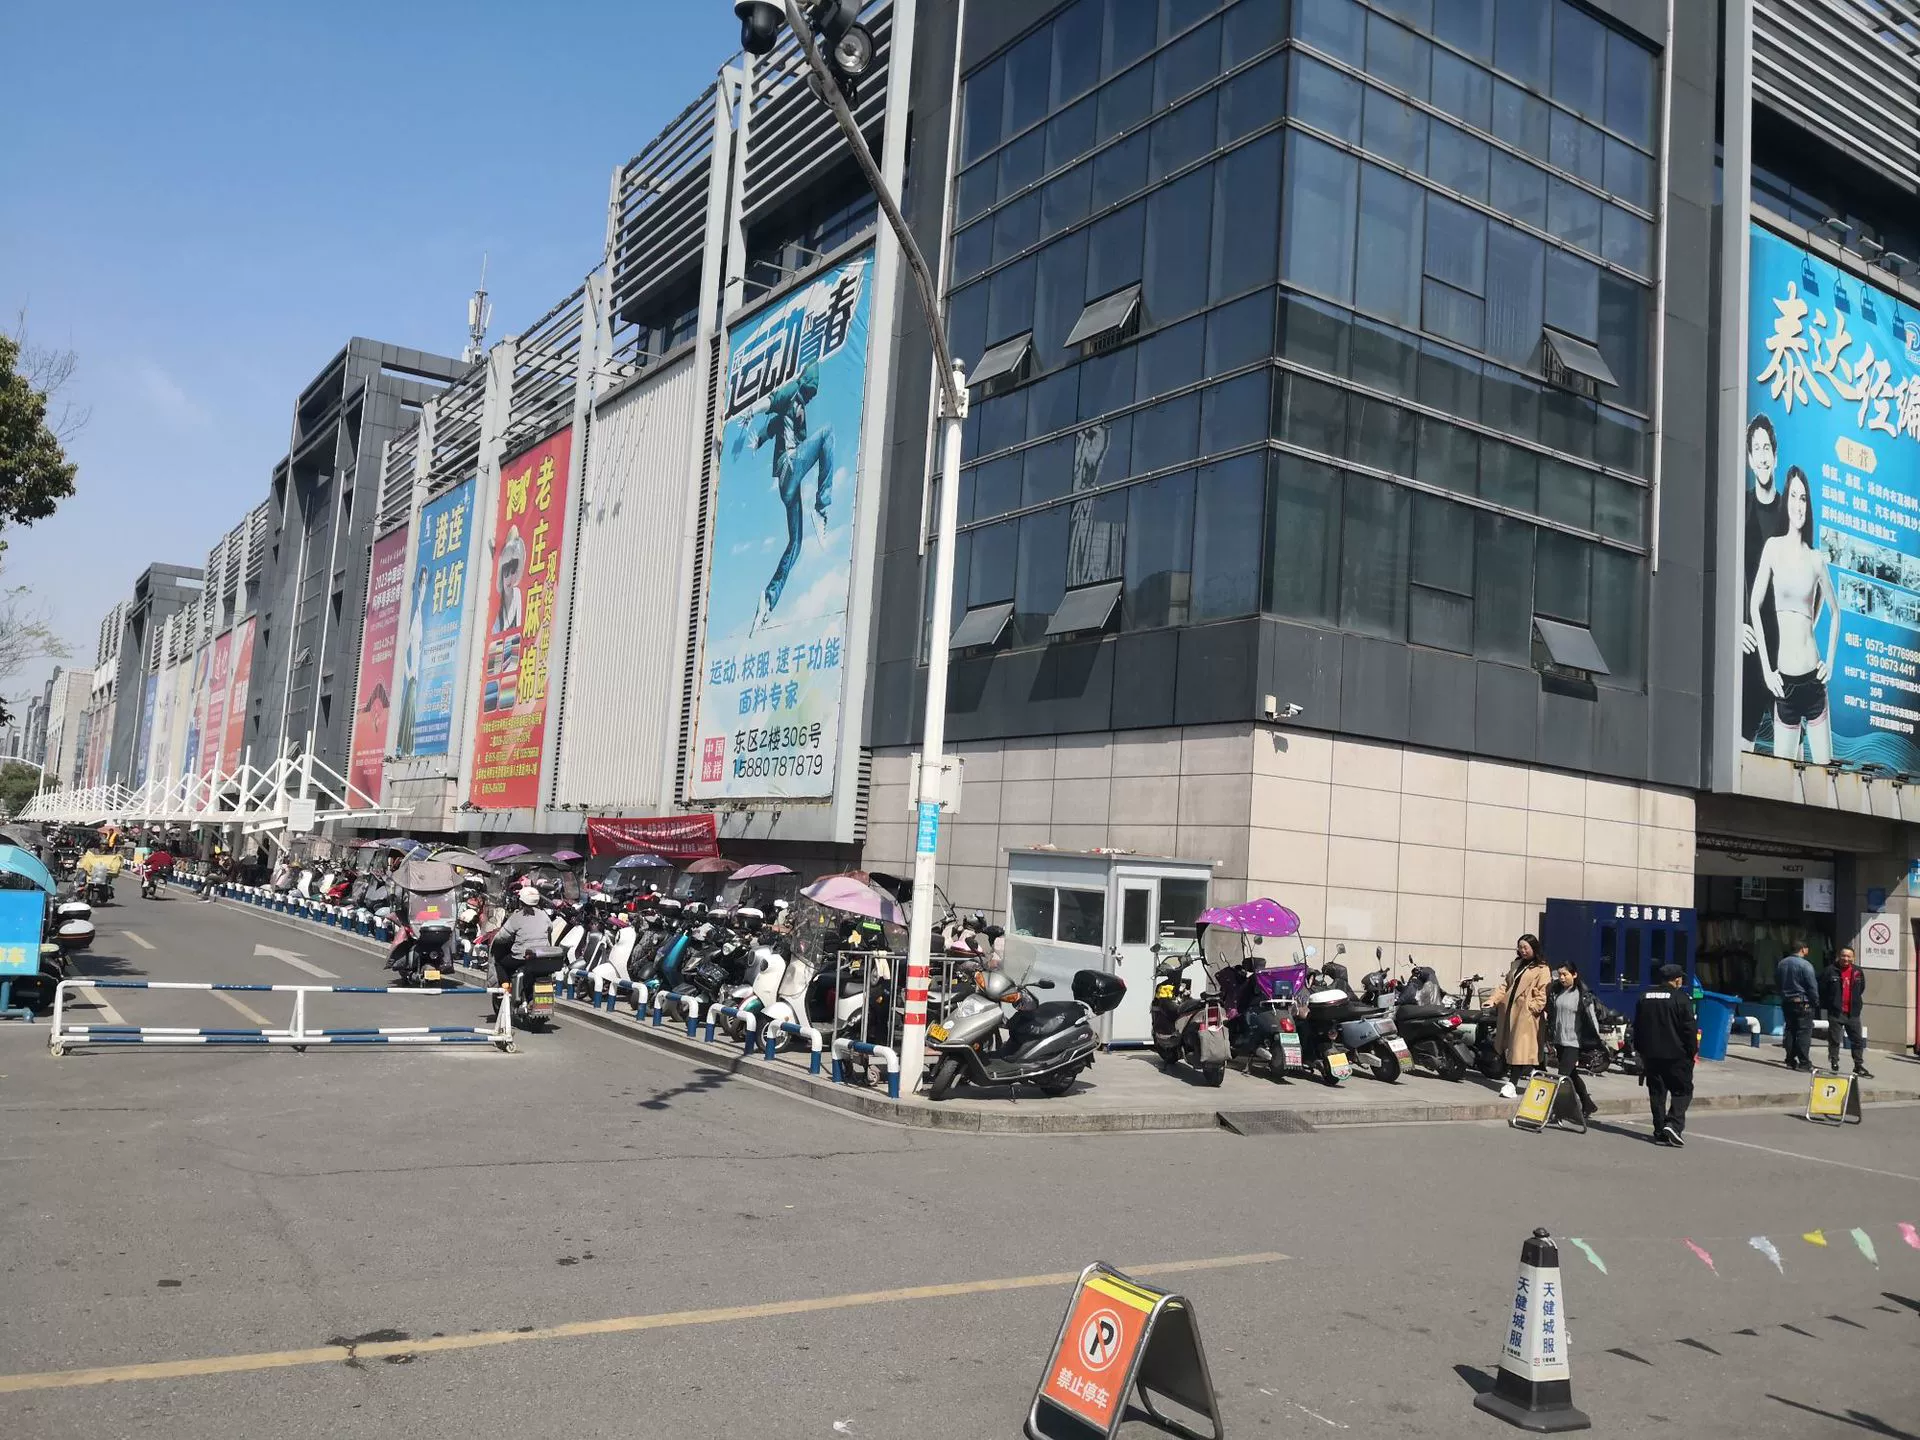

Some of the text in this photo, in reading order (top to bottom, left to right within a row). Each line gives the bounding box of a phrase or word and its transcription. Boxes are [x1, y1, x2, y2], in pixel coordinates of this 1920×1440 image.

[738, 680, 799, 715] 面料专家
[734, 722, 822, 755] 东区2楼306号
[1508, 1275, 1530, 1349] 天健城服
[1542, 1282, 1556, 1354] 天健城服
[1055, 1366, 1110, 1410] 禁止停车
